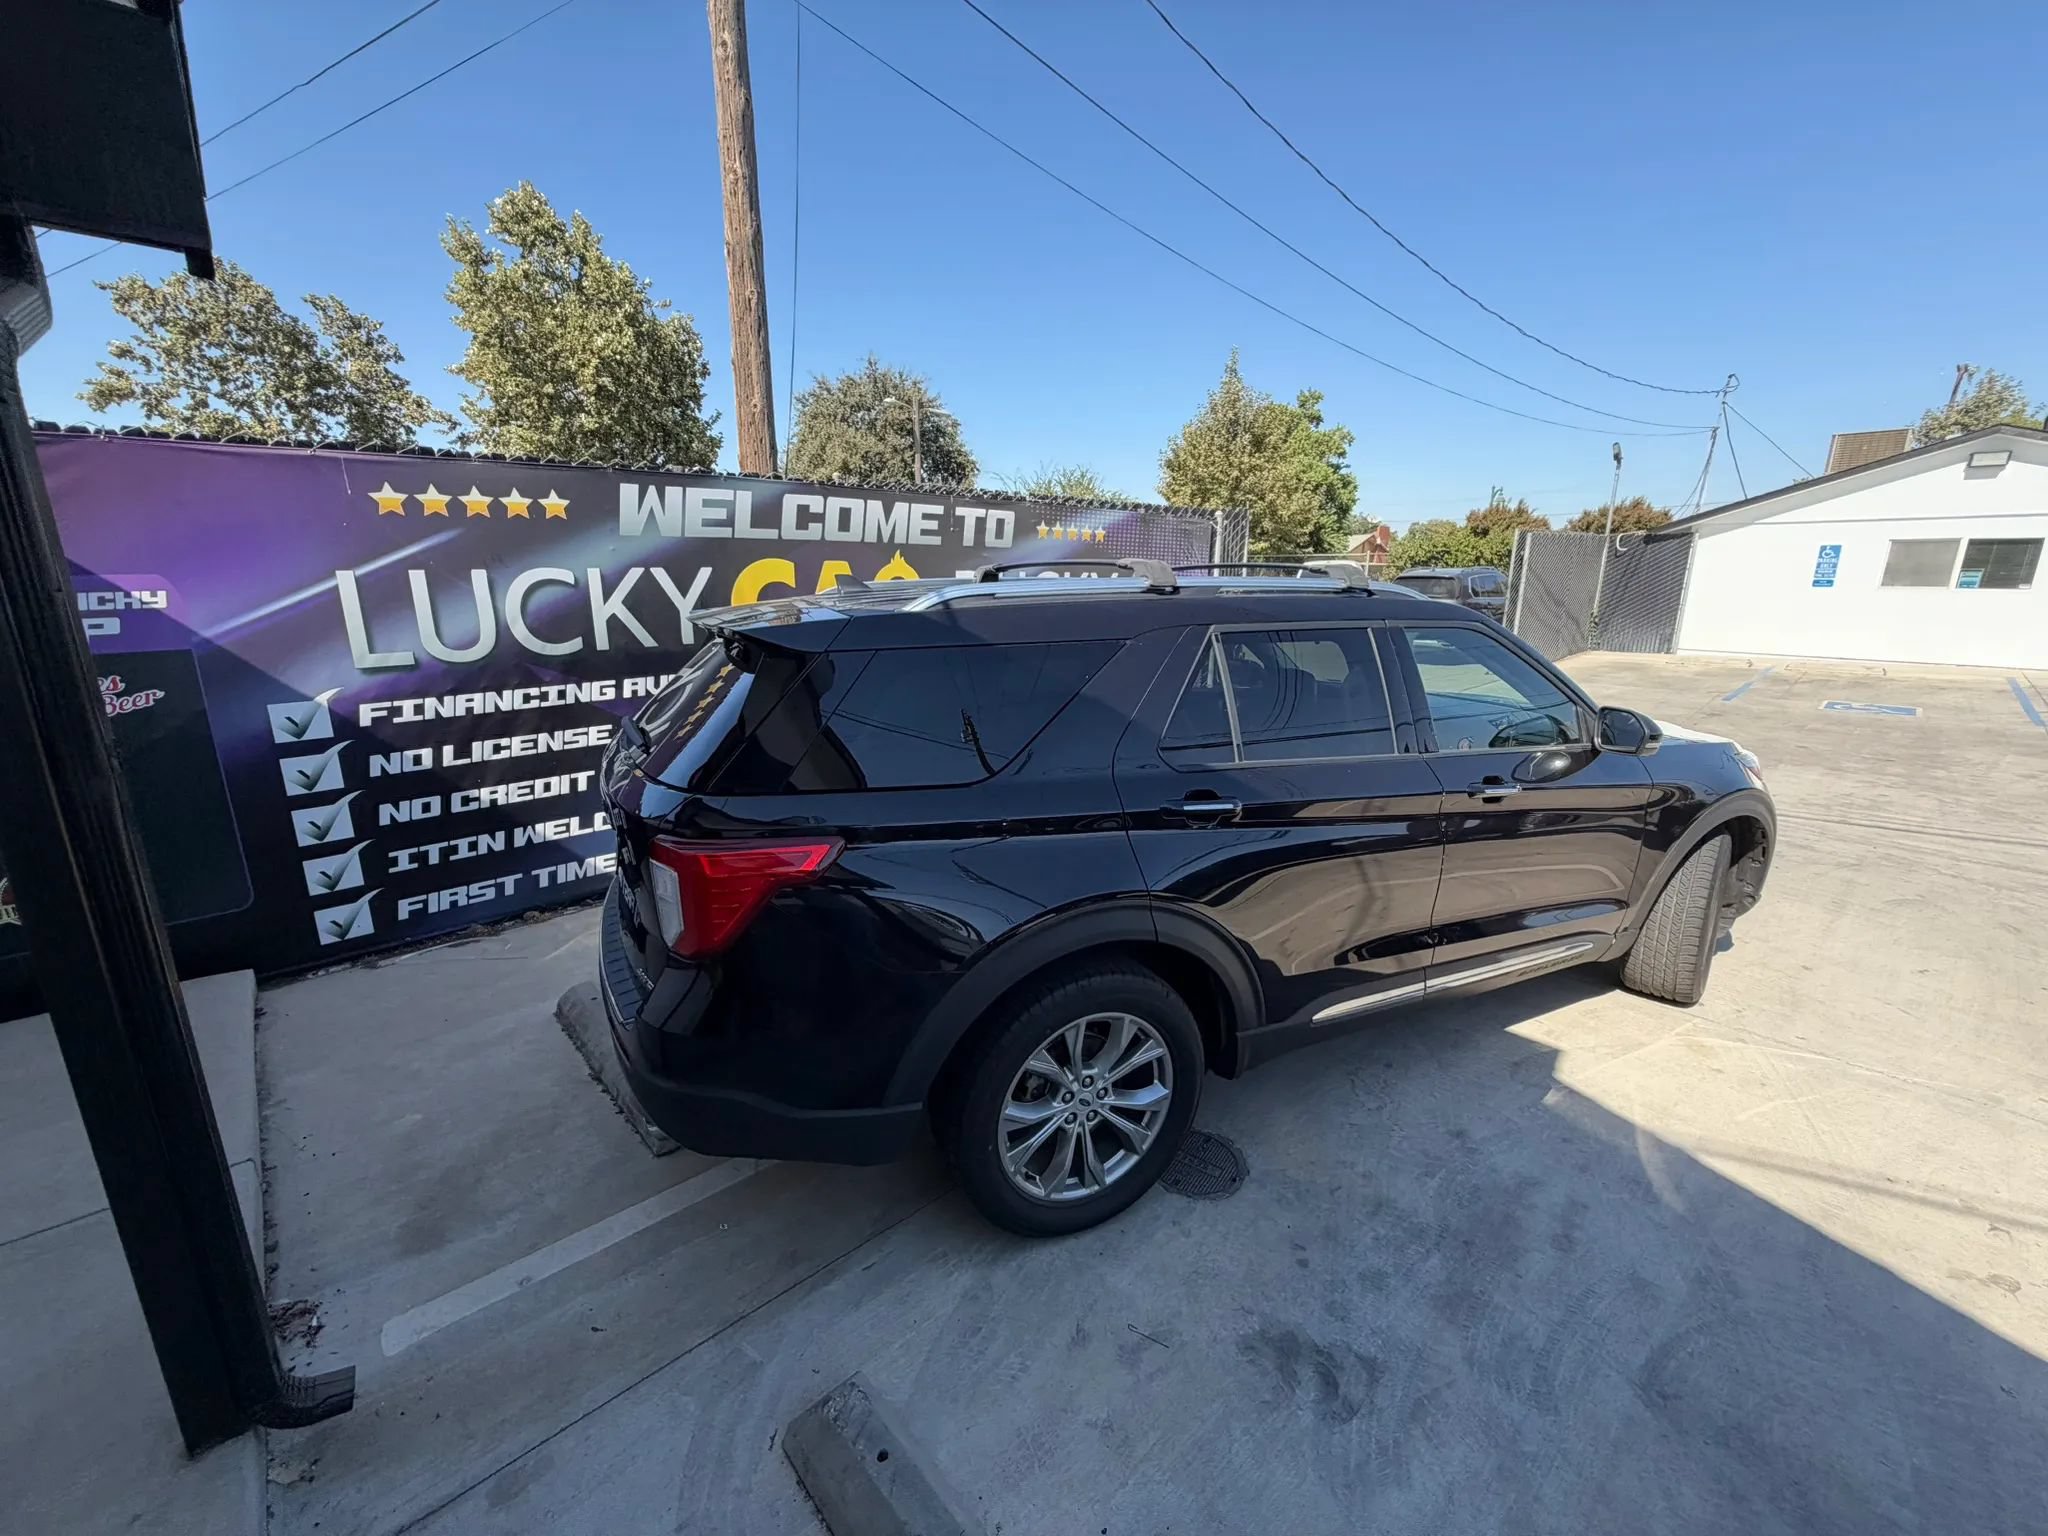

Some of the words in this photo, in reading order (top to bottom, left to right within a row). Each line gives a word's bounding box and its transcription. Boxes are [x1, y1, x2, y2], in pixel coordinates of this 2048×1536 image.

[619, 483, 944, 545] WELCOME
[956, 507, 1015, 548] TO
[335, 567, 712, 668] LUCKY
[359, 680, 616, 727] FINANCING
[369, 747, 433, 778] NO
[442, 724, 613, 767] LICENSE
[379, 795, 441, 826] NO
[451, 770, 595, 814] CREDIT
[388, 830, 505, 874] ITIN
[398, 873, 522, 920] FIRST
[531, 853, 617, 889] TIME
